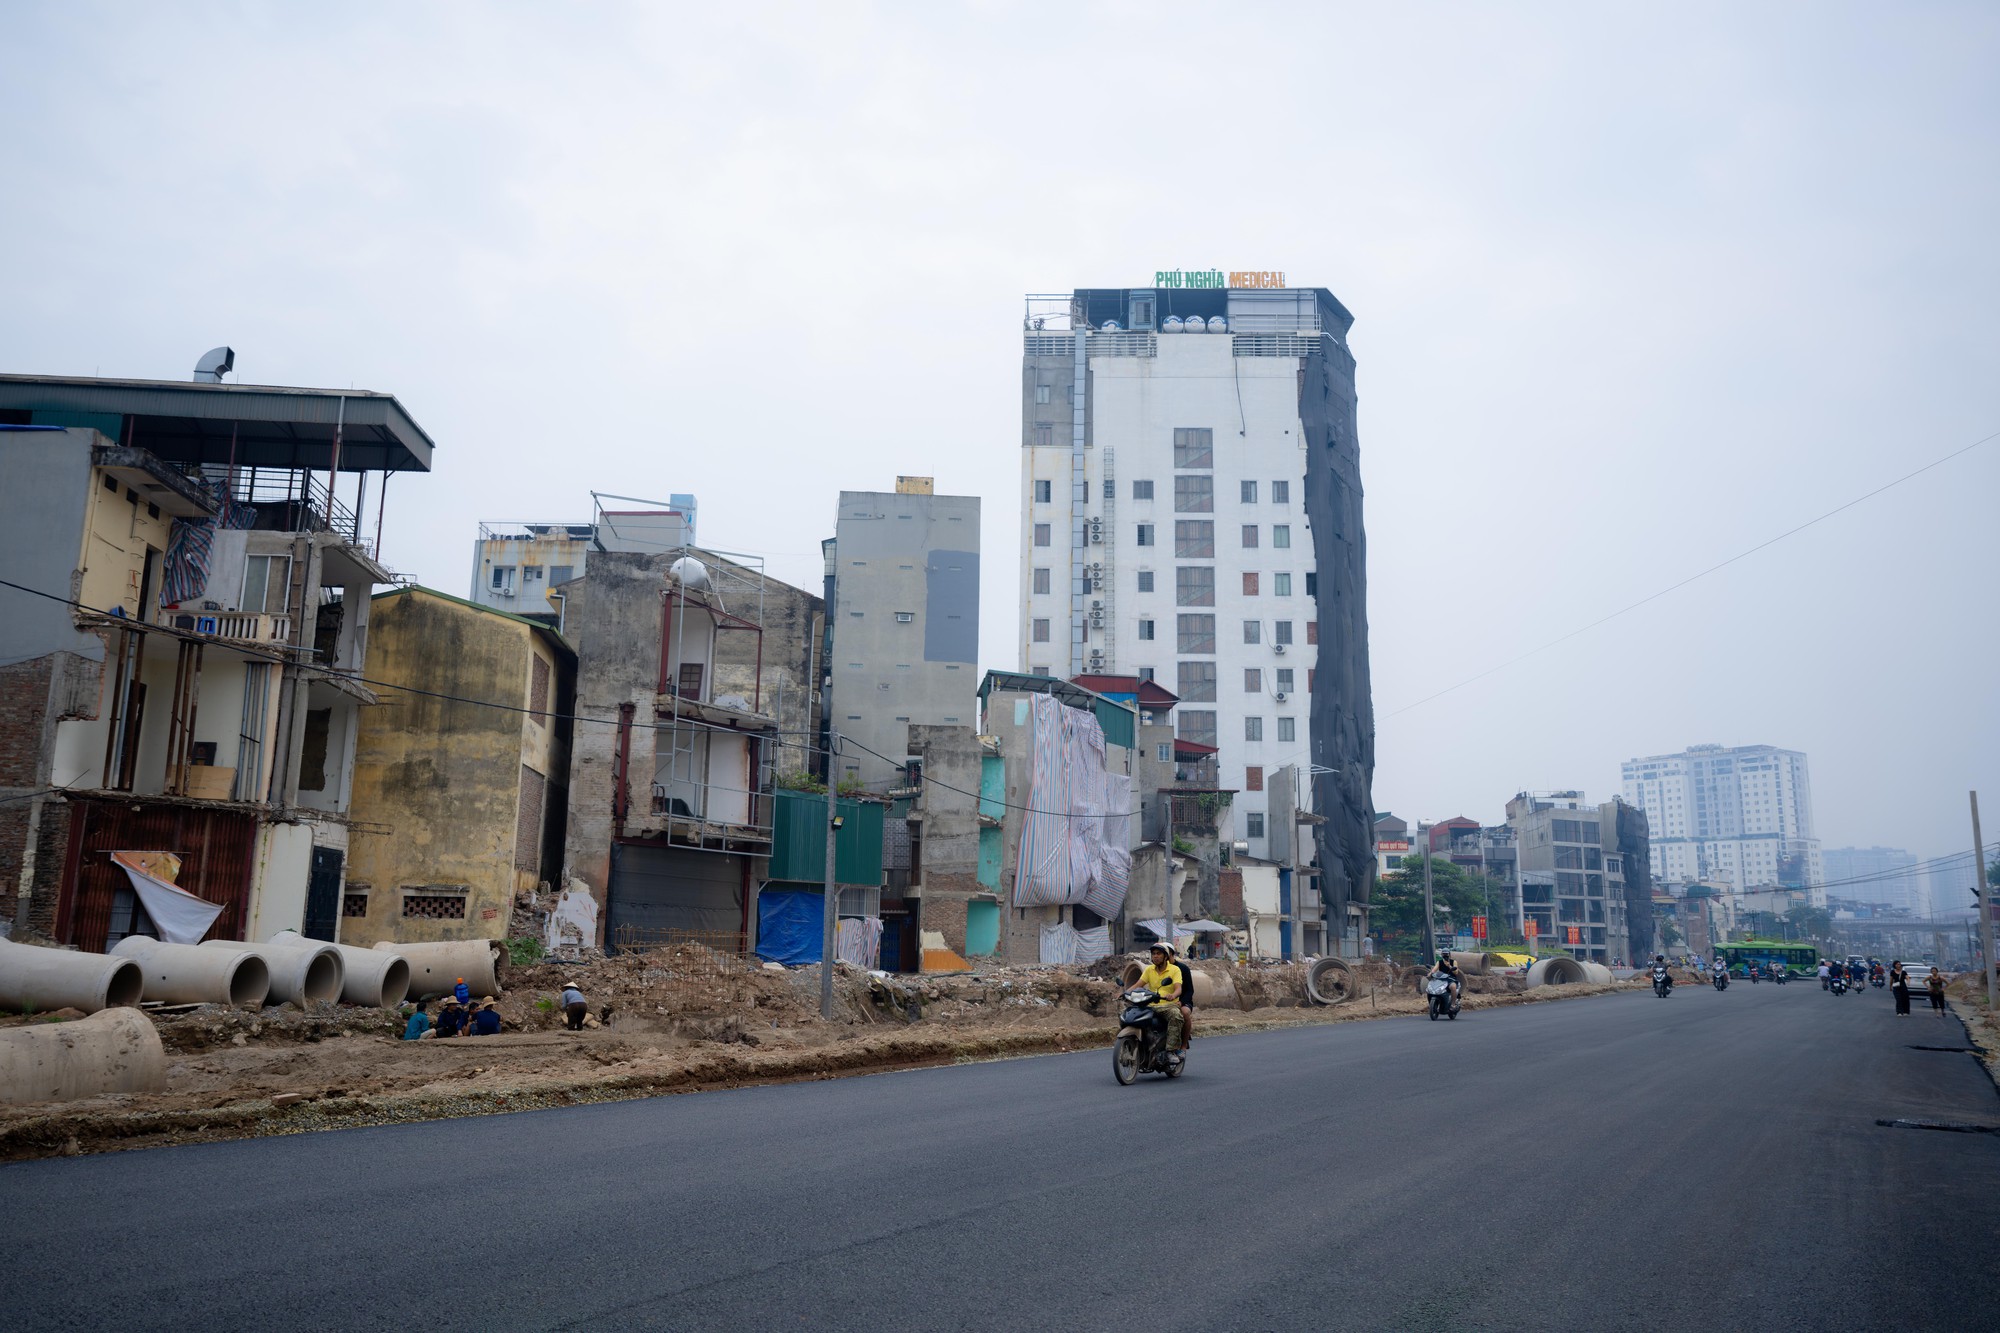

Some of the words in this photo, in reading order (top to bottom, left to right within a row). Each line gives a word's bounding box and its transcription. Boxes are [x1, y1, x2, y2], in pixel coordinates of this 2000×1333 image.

[1156, 268, 1181, 288] PHÚ
[1186, 268, 1224, 288] NGHĨA
[1229, 271, 1285, 288] MEDICAL
